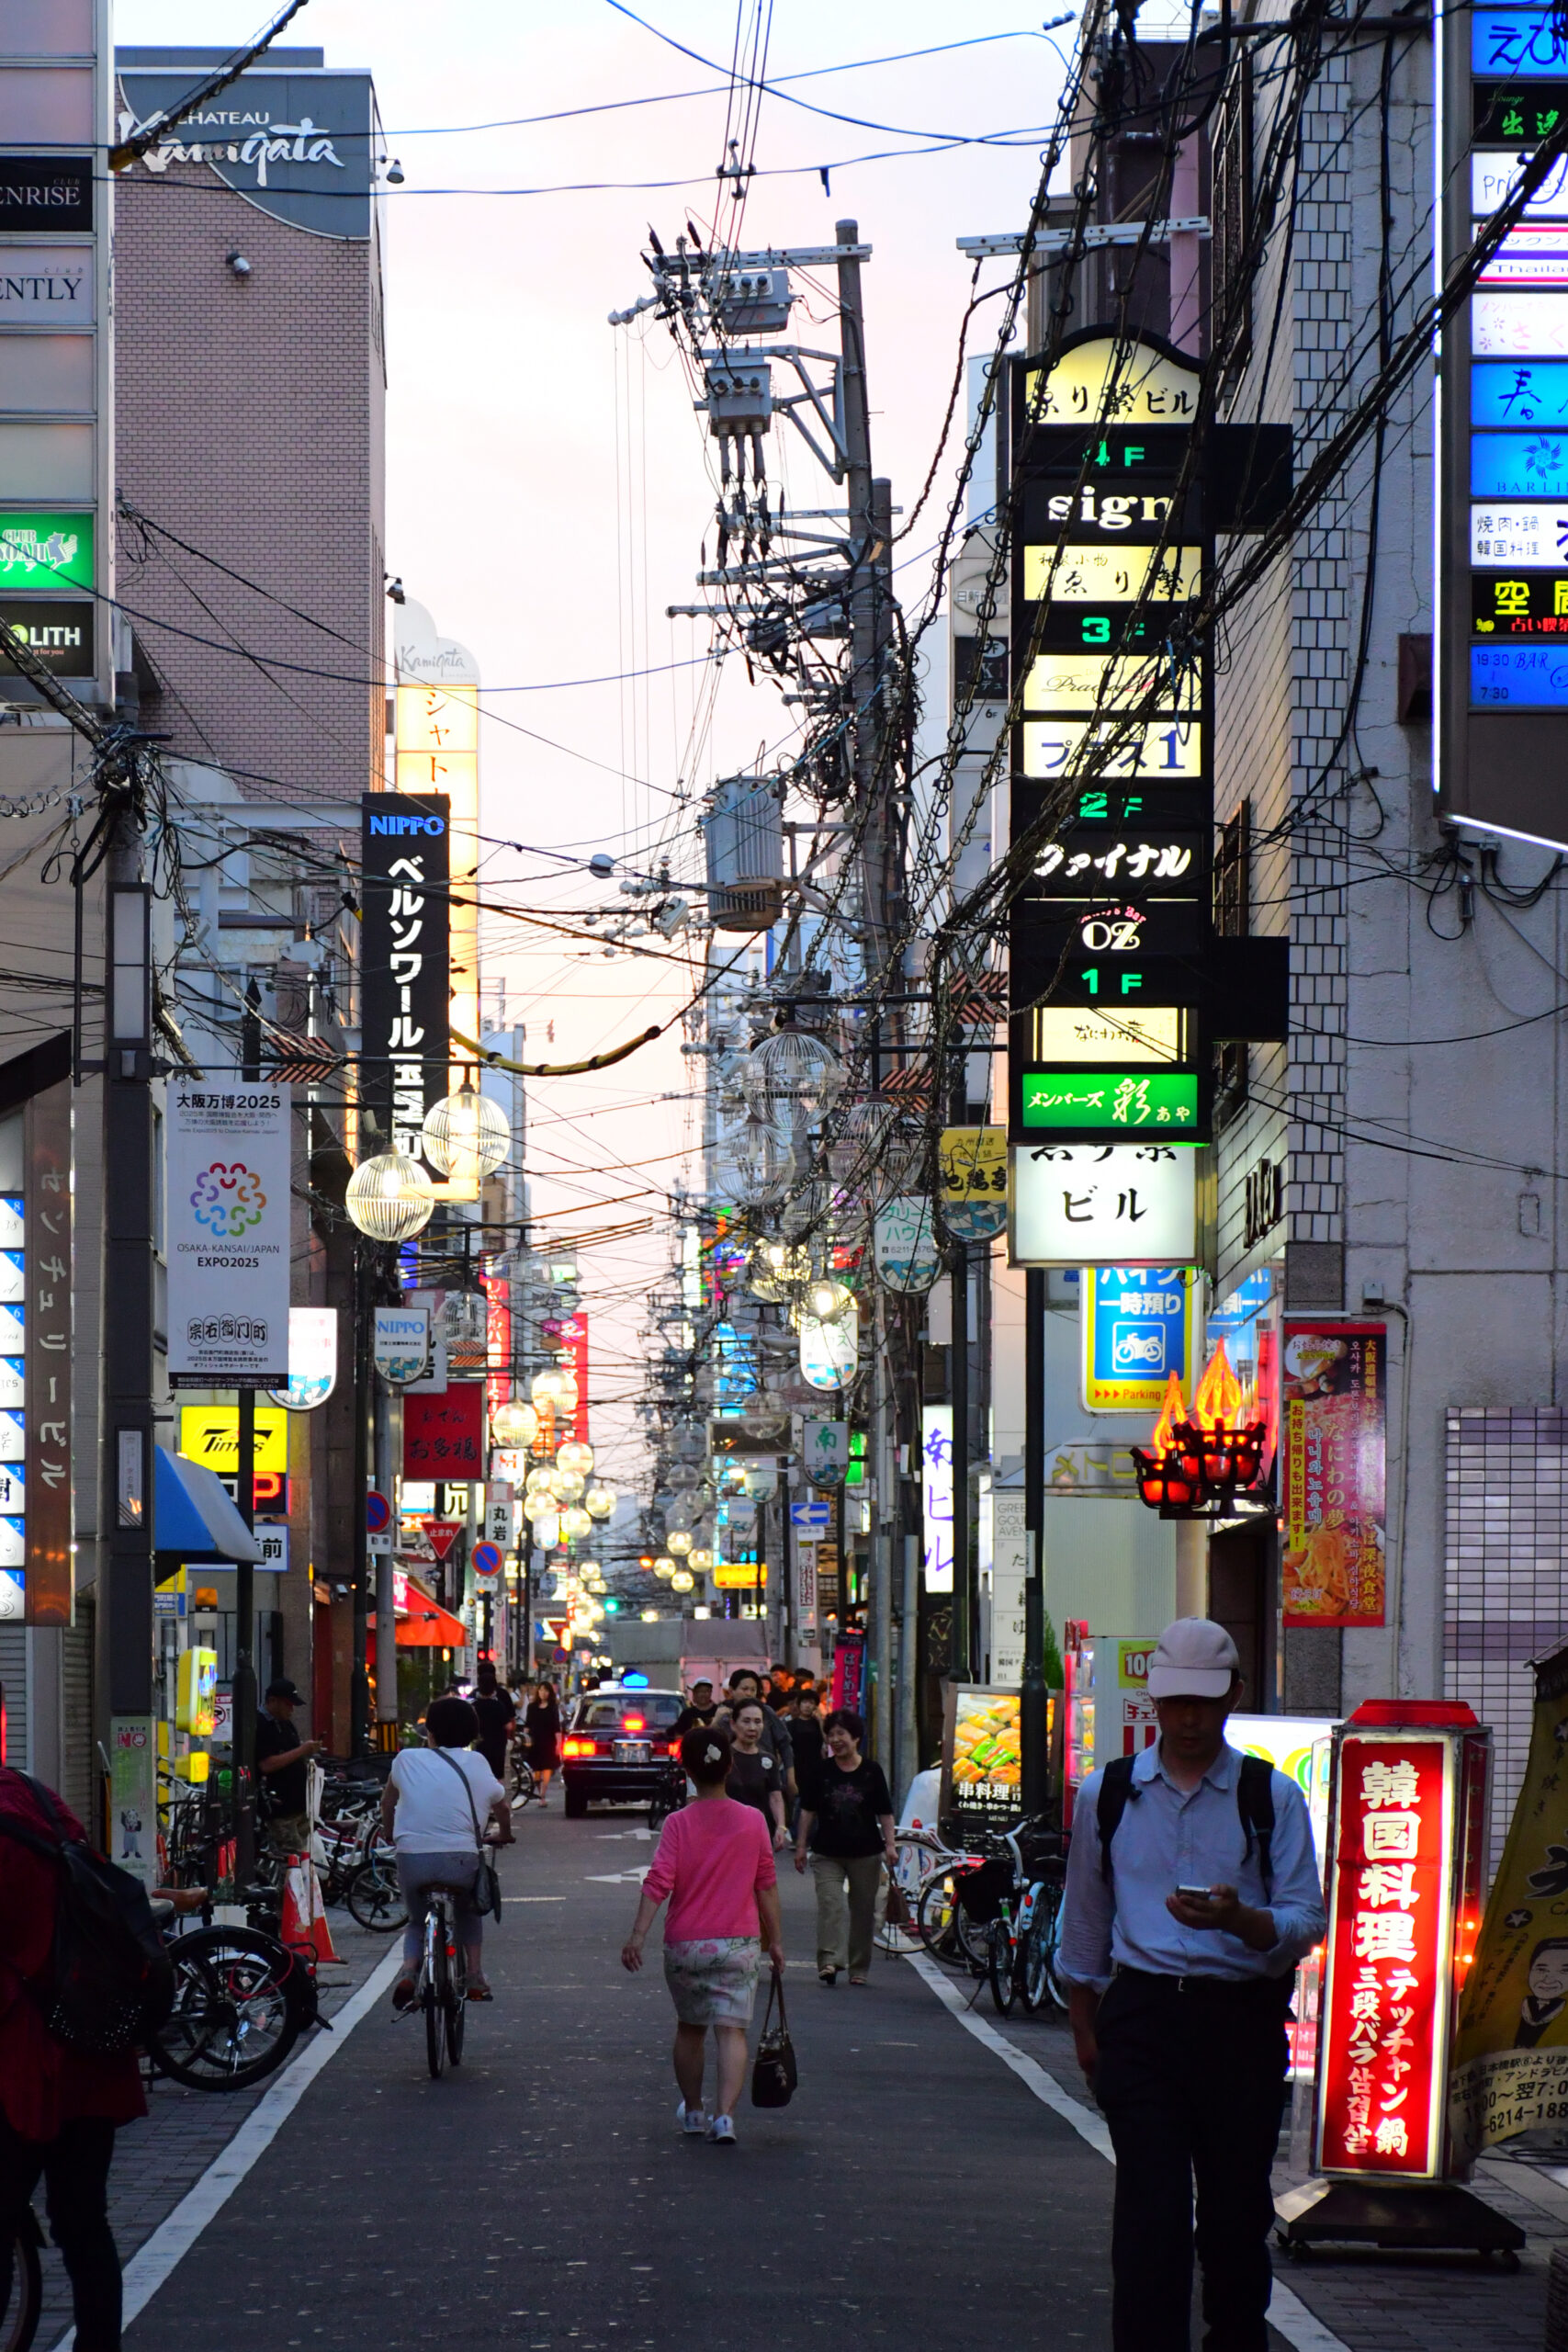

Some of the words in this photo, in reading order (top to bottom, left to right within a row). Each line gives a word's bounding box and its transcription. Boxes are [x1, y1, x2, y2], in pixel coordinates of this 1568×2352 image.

[0, 187, 81, 206] NRISE
[1492, 264, 1568, 273] Thaila
[0, 277, 82, 300] NTLY
[3, 529, 37, 543] CLUB
[1477, 540, 1539, 556] 韓国料理
[1481, 686, 1508, 699] 7:30
[370, 816, 445, 835] NIPPO
[1033, 843, 1191, 878] ファイナル
[1082, 922, 1141, 950] OZ
[177, 1093, 280, 1109] 大阪万博2025
[1028, 1091, 1105, 1108] メンバーズ
[1111, 1078, 1151, 1125] 彩
[1156, 1106, 1190, 1122] あや
[14, 1202, 20, 1211] 8
[1063, 1185, 1147, 1223] ビル
[886, 1225, 931, 1240] ハウス
[177, 1243, 280, 1254] OSAKA-KANSAI/JAPAN
[14, 1254, 20, 1264] 7
[197, 1257, 259, 1268] EXPO2025
[1100, 1292, 1181, 1316] 一時預り
[14, 1308, 20, 1318] 6
[39, 1167, 67, 1488] センチュリービル
[378, 1320, 424, 1333] NIPPO
[14, 1361, 20, 1371] 5
[1122, 1389, 1161, 1401] Parking
[16, 1413, 23, 1423] 4
[193, 1429, 273, 1453] Tims
[15, 1467, 21, 1477] 3
[1326, 1422, 1346, 1531] なにわの夢
[254, 1473, 281, 1511] P
[14, 1521, 21, 1530] 2
[493, 1506, 507, 1541] 丸岩
[998, 1515, 1025, 1525] GOU
[429, 1528, 454, 1538] 止まれ
[15, 1573, 20, 1583] 1
[959, 1781, 1010, 1801] 串料理
[1355, 1759, 1422, 1962] 韓国料理
[1374, 1969, 1419, 2157] テッチャン鍋
